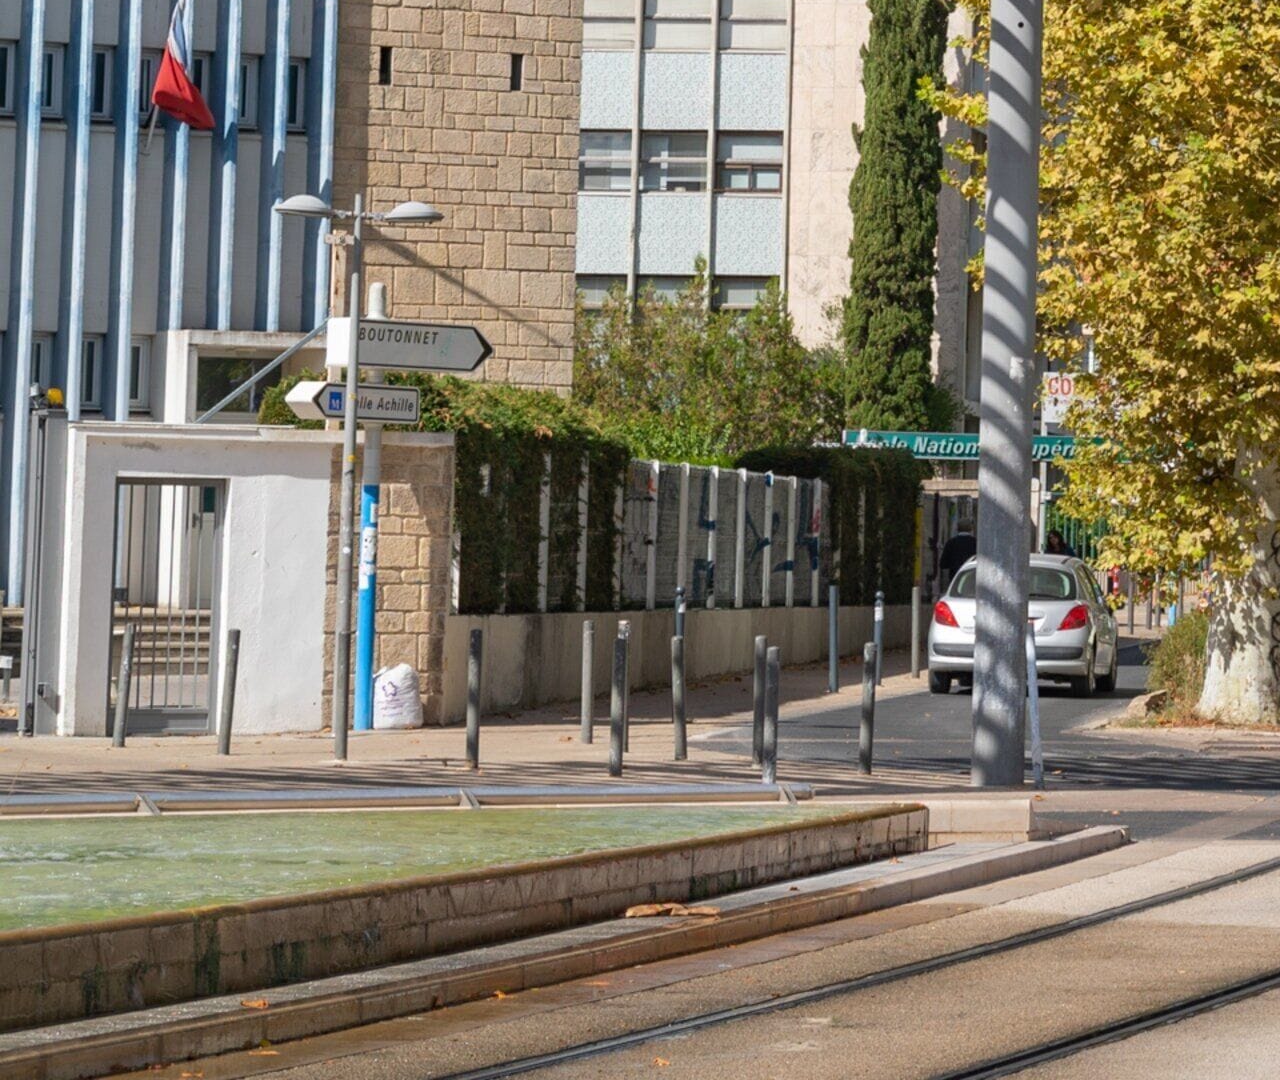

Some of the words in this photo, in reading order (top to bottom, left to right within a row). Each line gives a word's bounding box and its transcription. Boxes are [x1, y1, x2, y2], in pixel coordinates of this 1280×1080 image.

[359, 327, 440, 345] BOUTONNET
[377, 396, 415, 413] Achille
[913, 436, 981, 455] Nation
